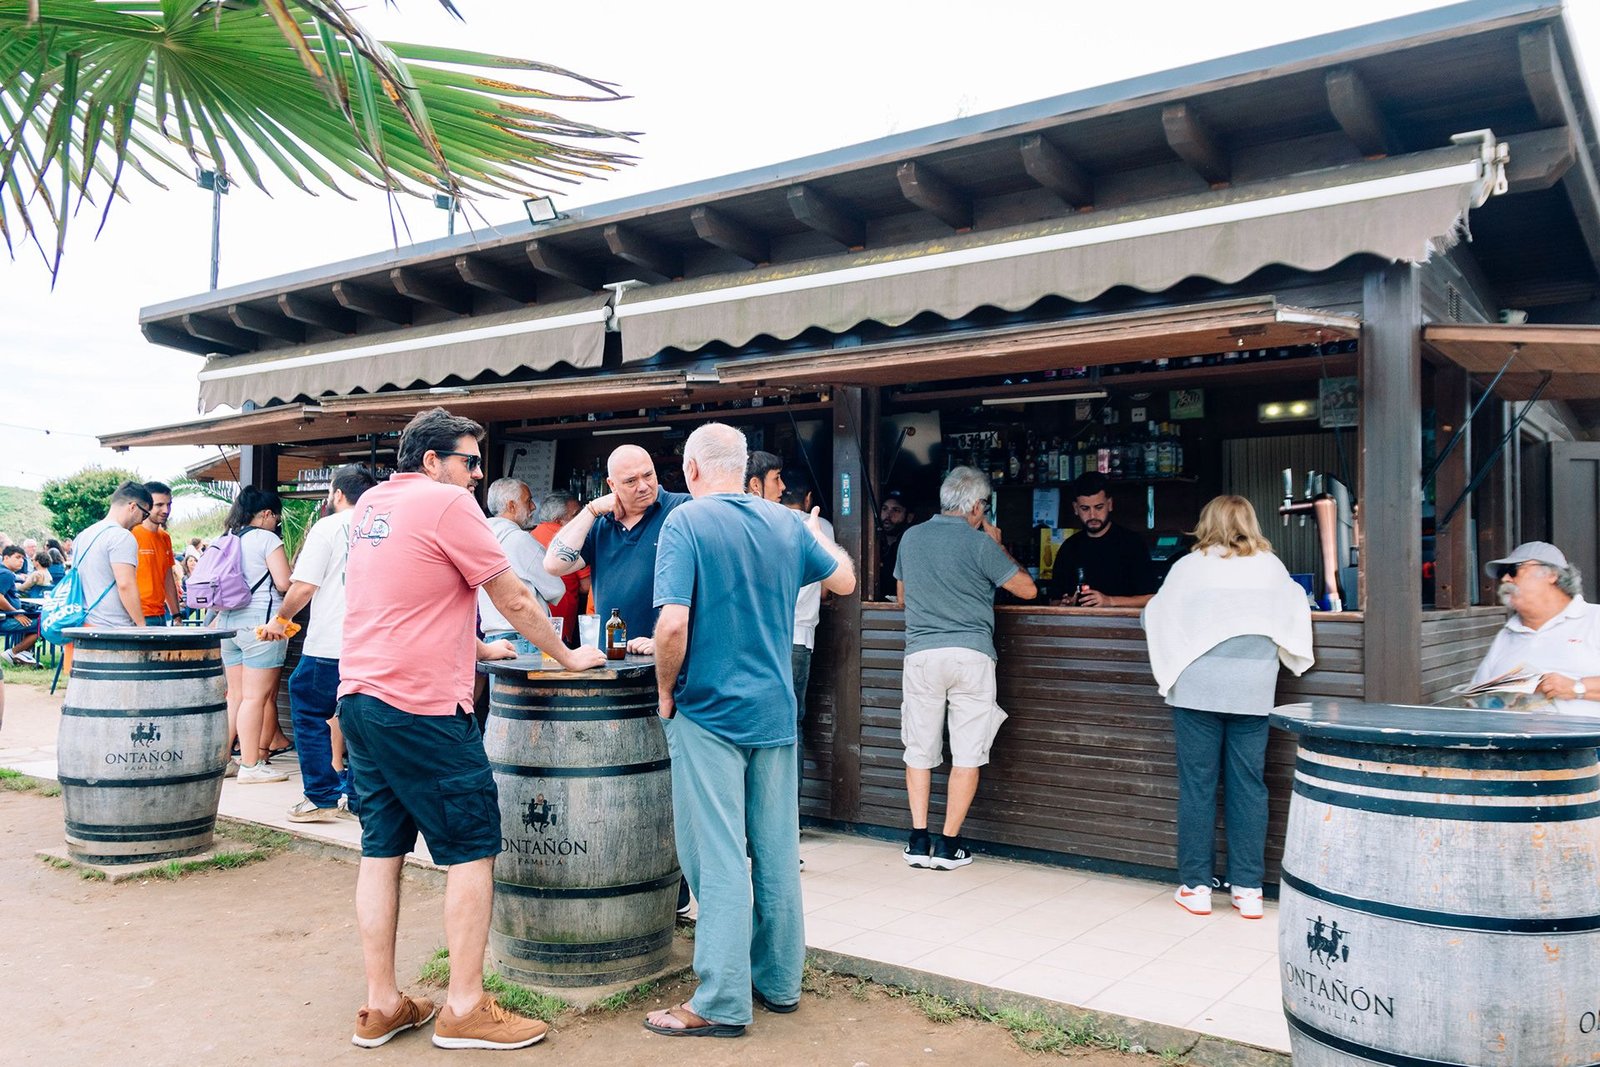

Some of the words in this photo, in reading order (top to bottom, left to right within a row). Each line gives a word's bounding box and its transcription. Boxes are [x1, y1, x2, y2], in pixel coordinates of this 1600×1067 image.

[105, 749, 184, 764] ONTAÑÓN
[518, 858, 562, 866] FAMILIA
[1286, 961, 1394, 1019] ONTAÑÓN
